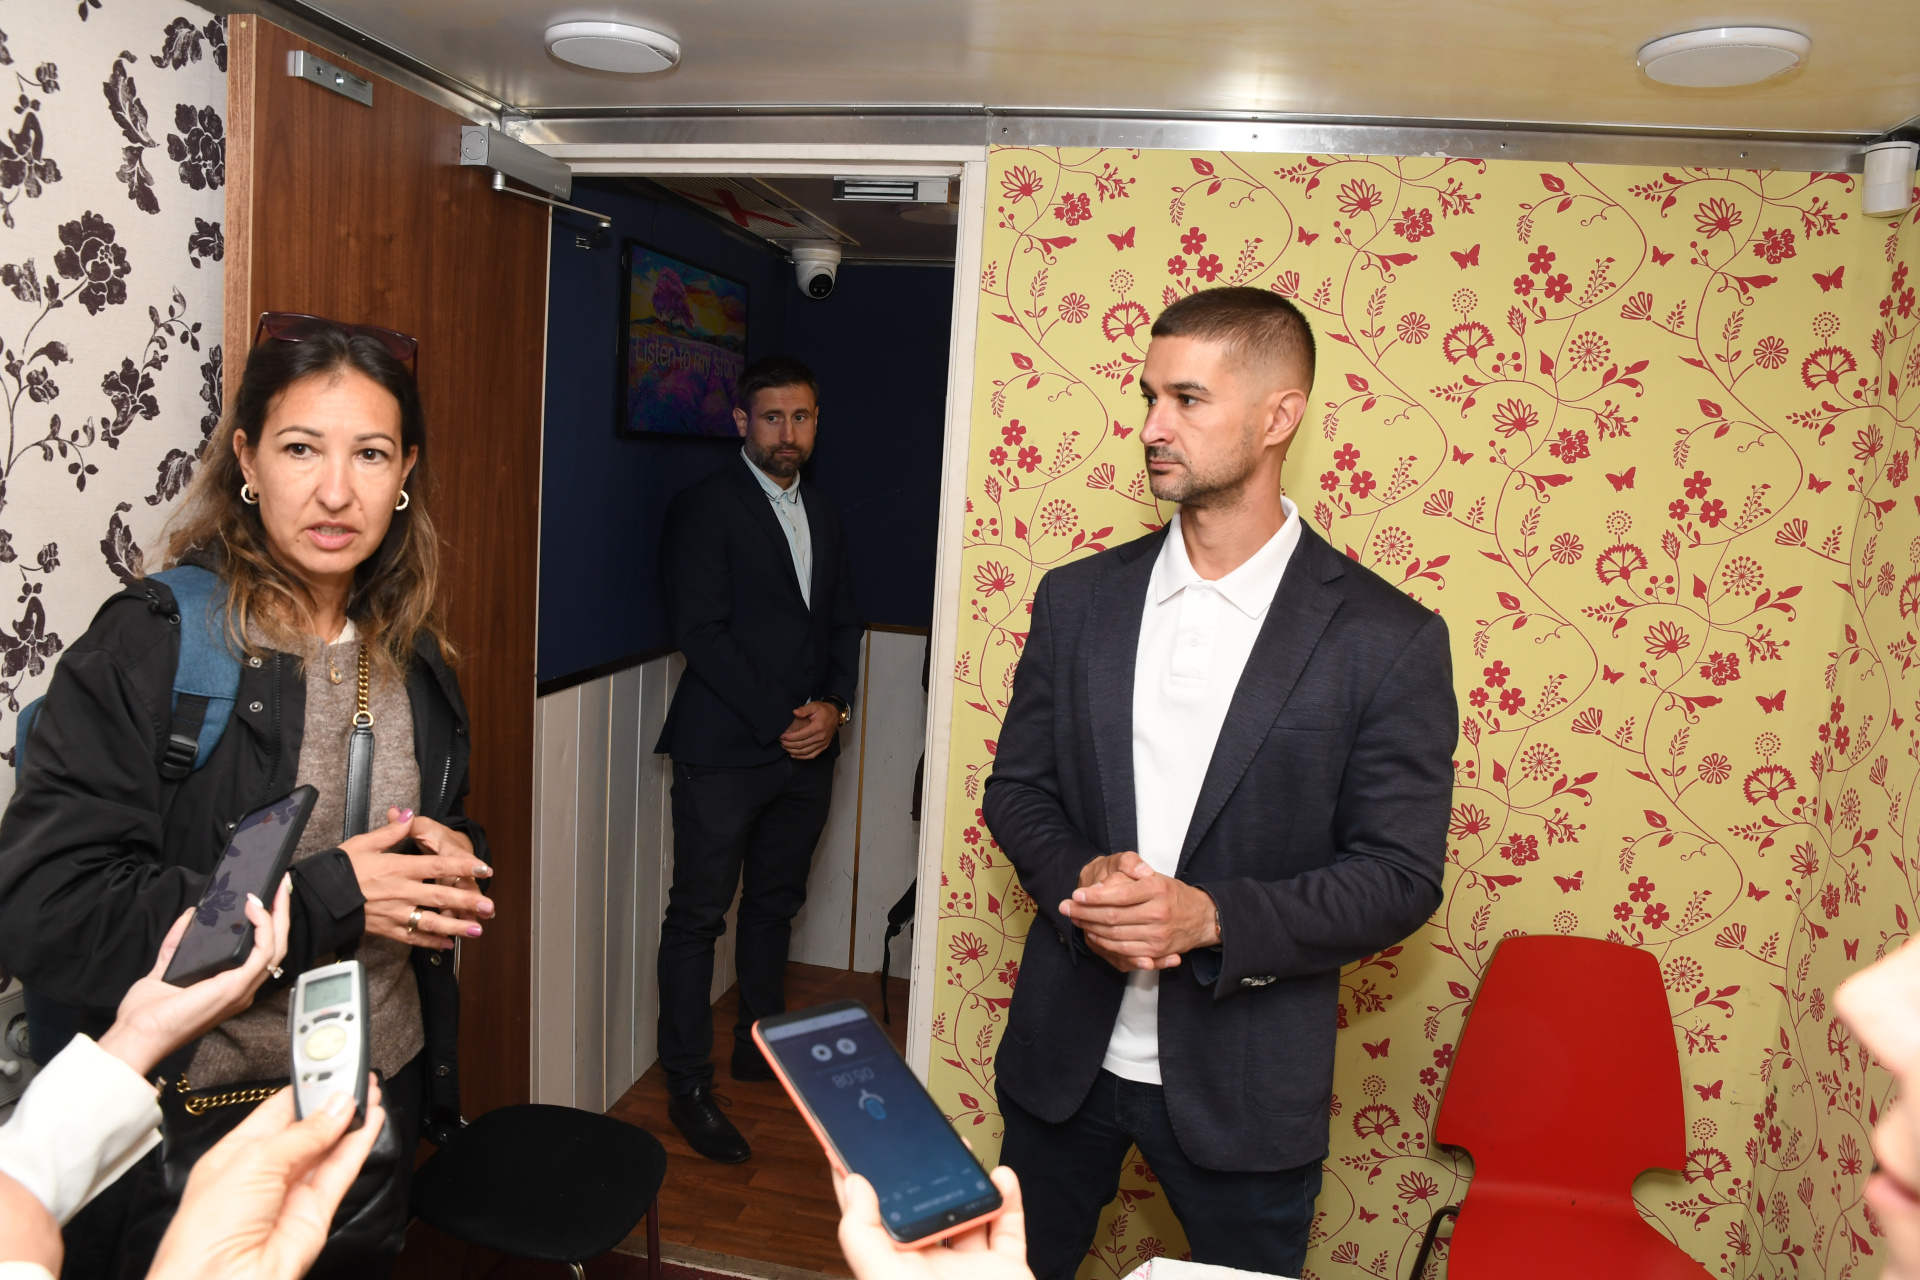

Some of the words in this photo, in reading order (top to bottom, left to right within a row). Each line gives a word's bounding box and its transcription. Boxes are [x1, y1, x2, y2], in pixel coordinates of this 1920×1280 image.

[635, 335, 676, 367] Listen
[679, 344, 691, 371] to
[694, 353, 712, 380] my
